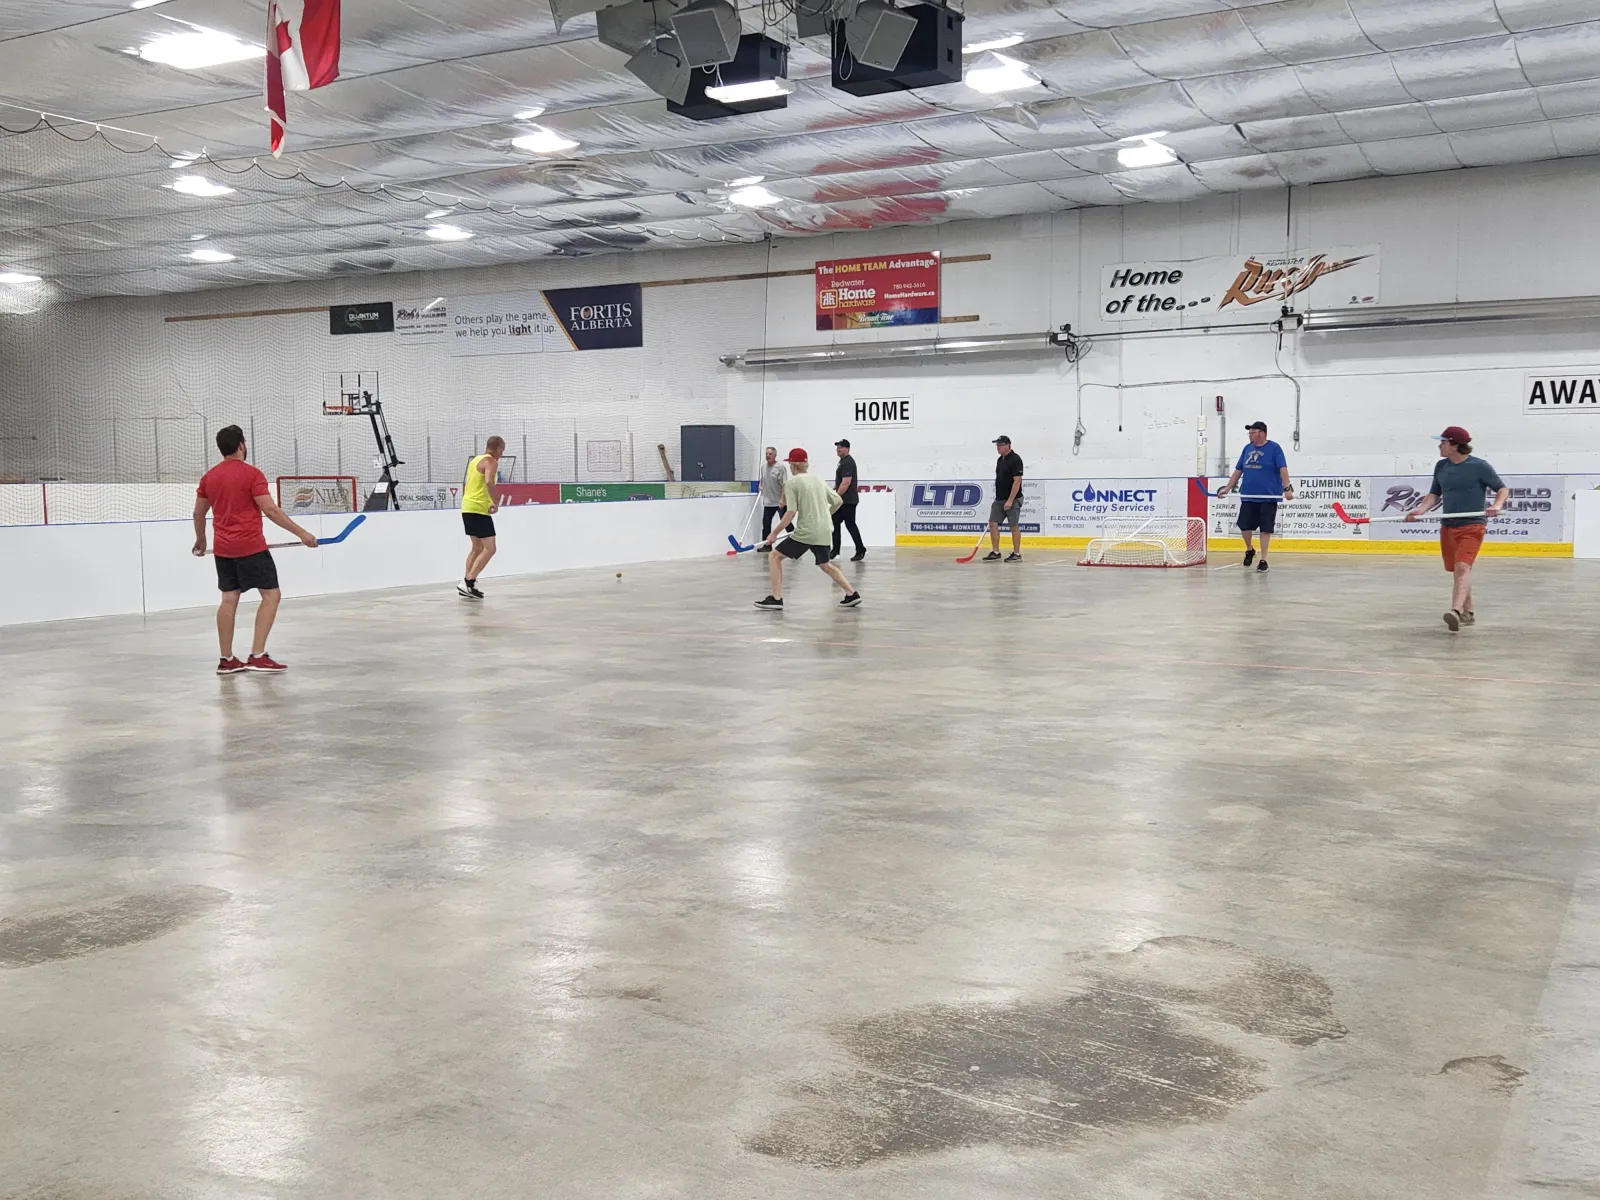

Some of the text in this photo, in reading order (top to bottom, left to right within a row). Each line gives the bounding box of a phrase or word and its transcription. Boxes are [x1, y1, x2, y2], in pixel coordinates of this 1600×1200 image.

[818, 258, 937, 275] The HOME TEAM Advantage.
[831, 279, 865, 288] Redwater
[1109, 268, 1184, 288] Home
[838, 288, 876, 300] Home
[884, 290, 935, 299] HomeHardware.ca
[838, 299, 876, 308] hardware
[1105, 294, 1136, 314] of
[348, 312, 379, 322] QUANTUM
[570, 302, 632, 320] FORTIS
[454, 312, 549, 325] Others play the game,
[570, 317, 633, 331] ALBERTA
[455, 329, 467, 337] we
[469, 326, 489, 337] help
[491, 327, 507, 337] you
[508, 324, 532, 336] light
[534, 323, 541, 333] it
[543, 324, 557, 335] up.
[1528, 379, 1600, 405] AWA
[855, 400, 910, 421] HOME
[1300, 479, 1361, 488] PLUMBING &
[576, 486, 607, 497] Shane's
[911, 483, 984, 508] LTD
[1072, 482, 1157, 502] CONNECT
[1300, 490, 1362, 499] GASFITTING INC
[1073, 503, 1155, 513] Energy Services
